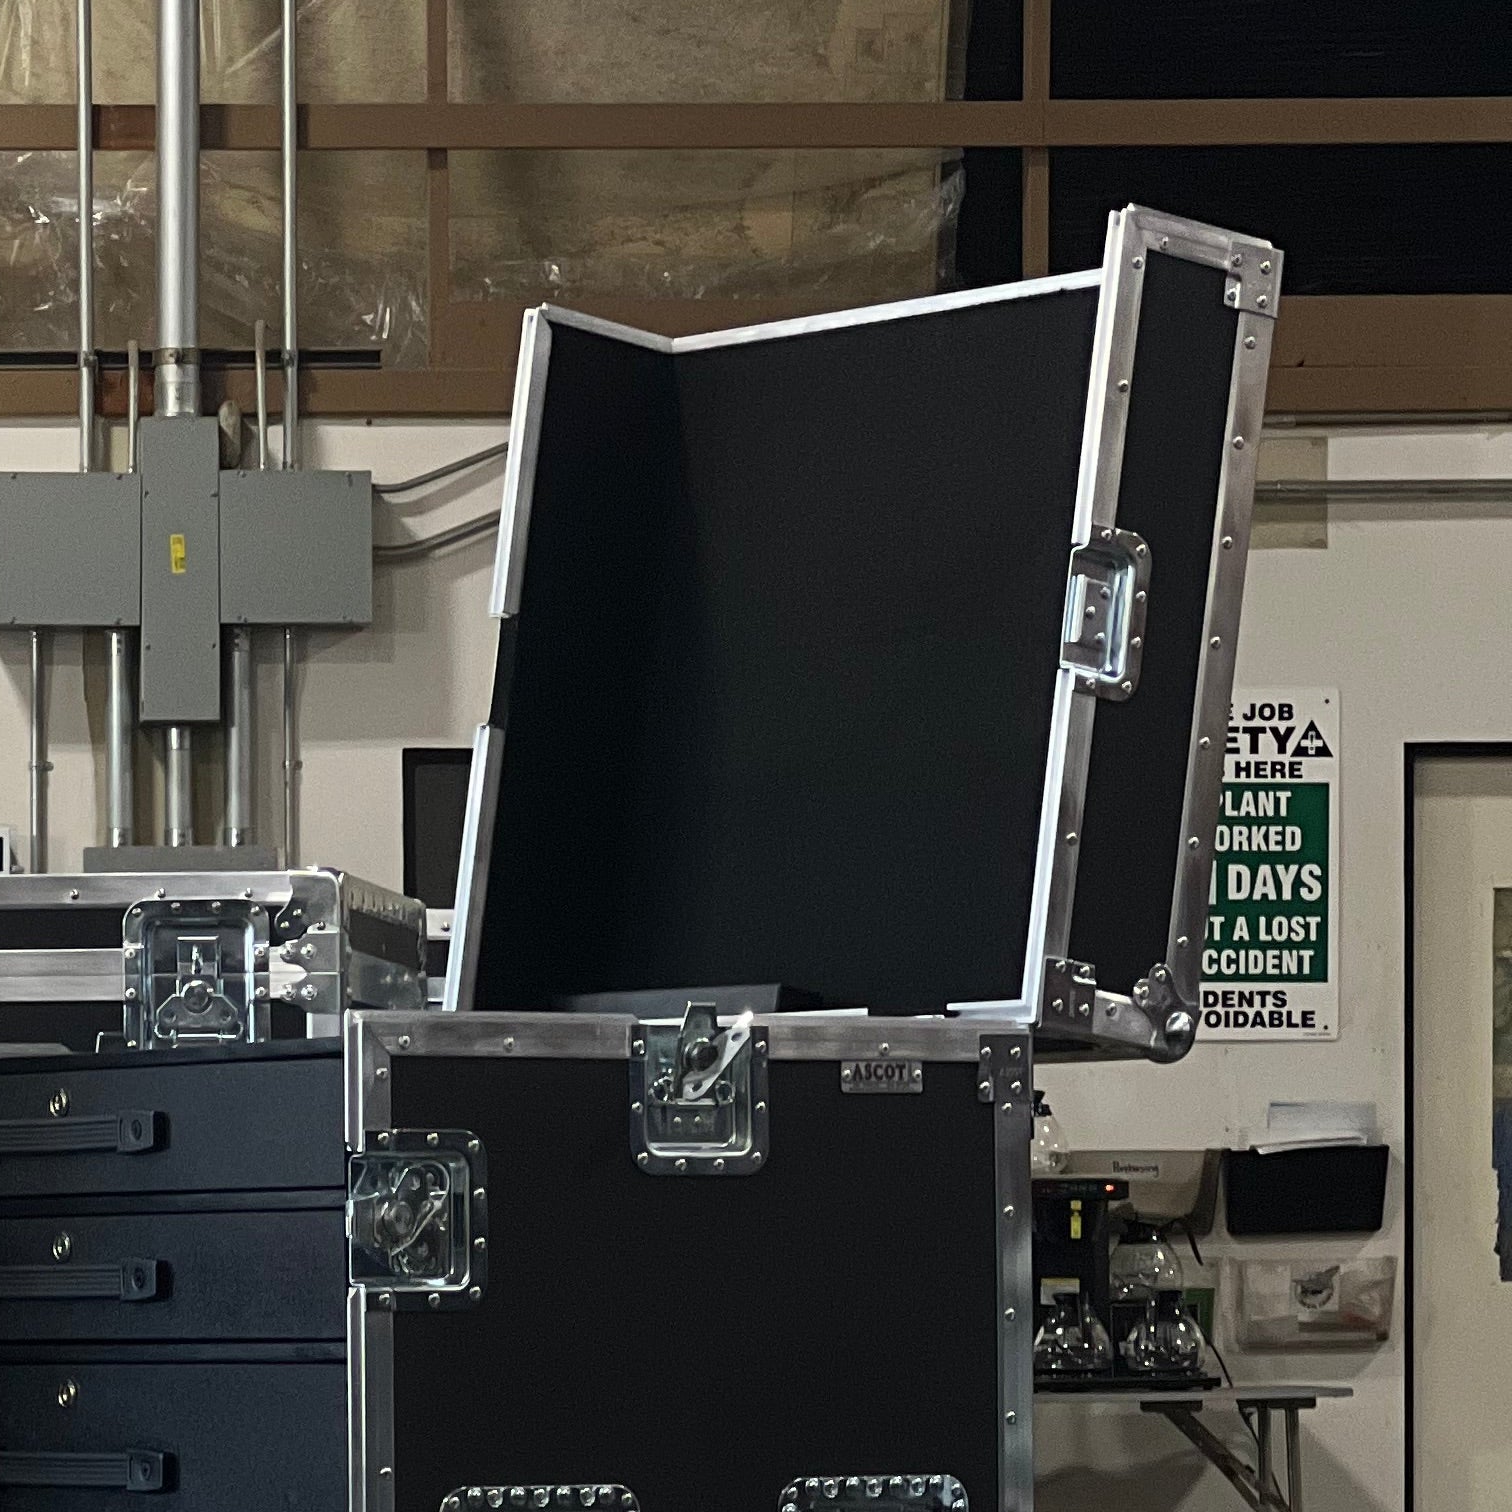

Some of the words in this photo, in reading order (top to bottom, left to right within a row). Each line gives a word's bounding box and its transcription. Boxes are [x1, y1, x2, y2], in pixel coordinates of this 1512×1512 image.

[1243, 703, 1294, 721] JOB
[1225, 726, 1296, 755] ETY
[1235, 761, 1303, 779] HERE
[1220, 791, 1291, 817] LANT
[1215, 826, 1302, 852] ORKED
[1228, 864, 1322, 901] DAYS
[1233, 917, 1249, 940] A
[1260, 916, 1321, 941] LOST
[1202, 949, 1315, 975] CCIDENT
[1202, 990, 1288, 1008] DENTS
[1203, 1011, 1316, 1028] OIDABLE
[854, 1063, 906, 1081] ASCOT
